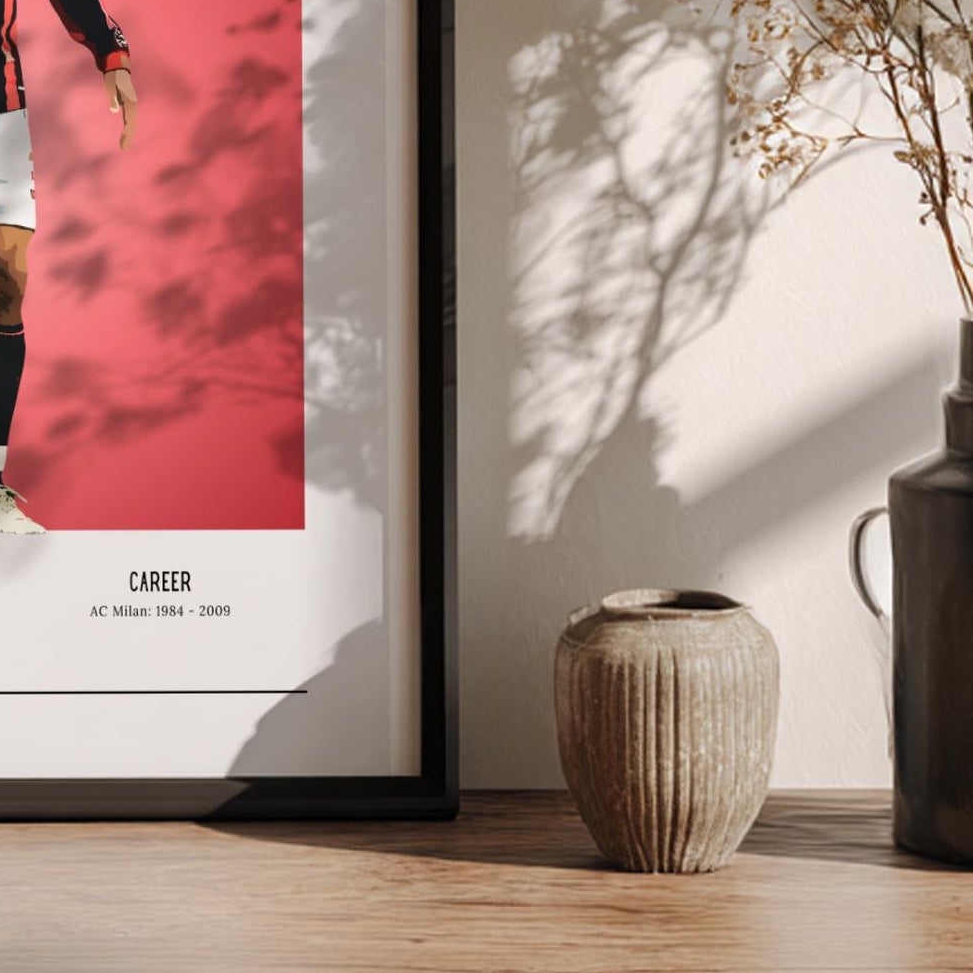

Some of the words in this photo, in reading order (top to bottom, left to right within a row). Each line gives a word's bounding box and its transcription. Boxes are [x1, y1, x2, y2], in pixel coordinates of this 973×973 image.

[129, 570, 191, 593] CAREER
[89, 605, 108, 617] AC
[112, 604, 152, 617] Milan:
[155, 605, 184, 617] 1984
[199, 605, 231, 617] 2009
